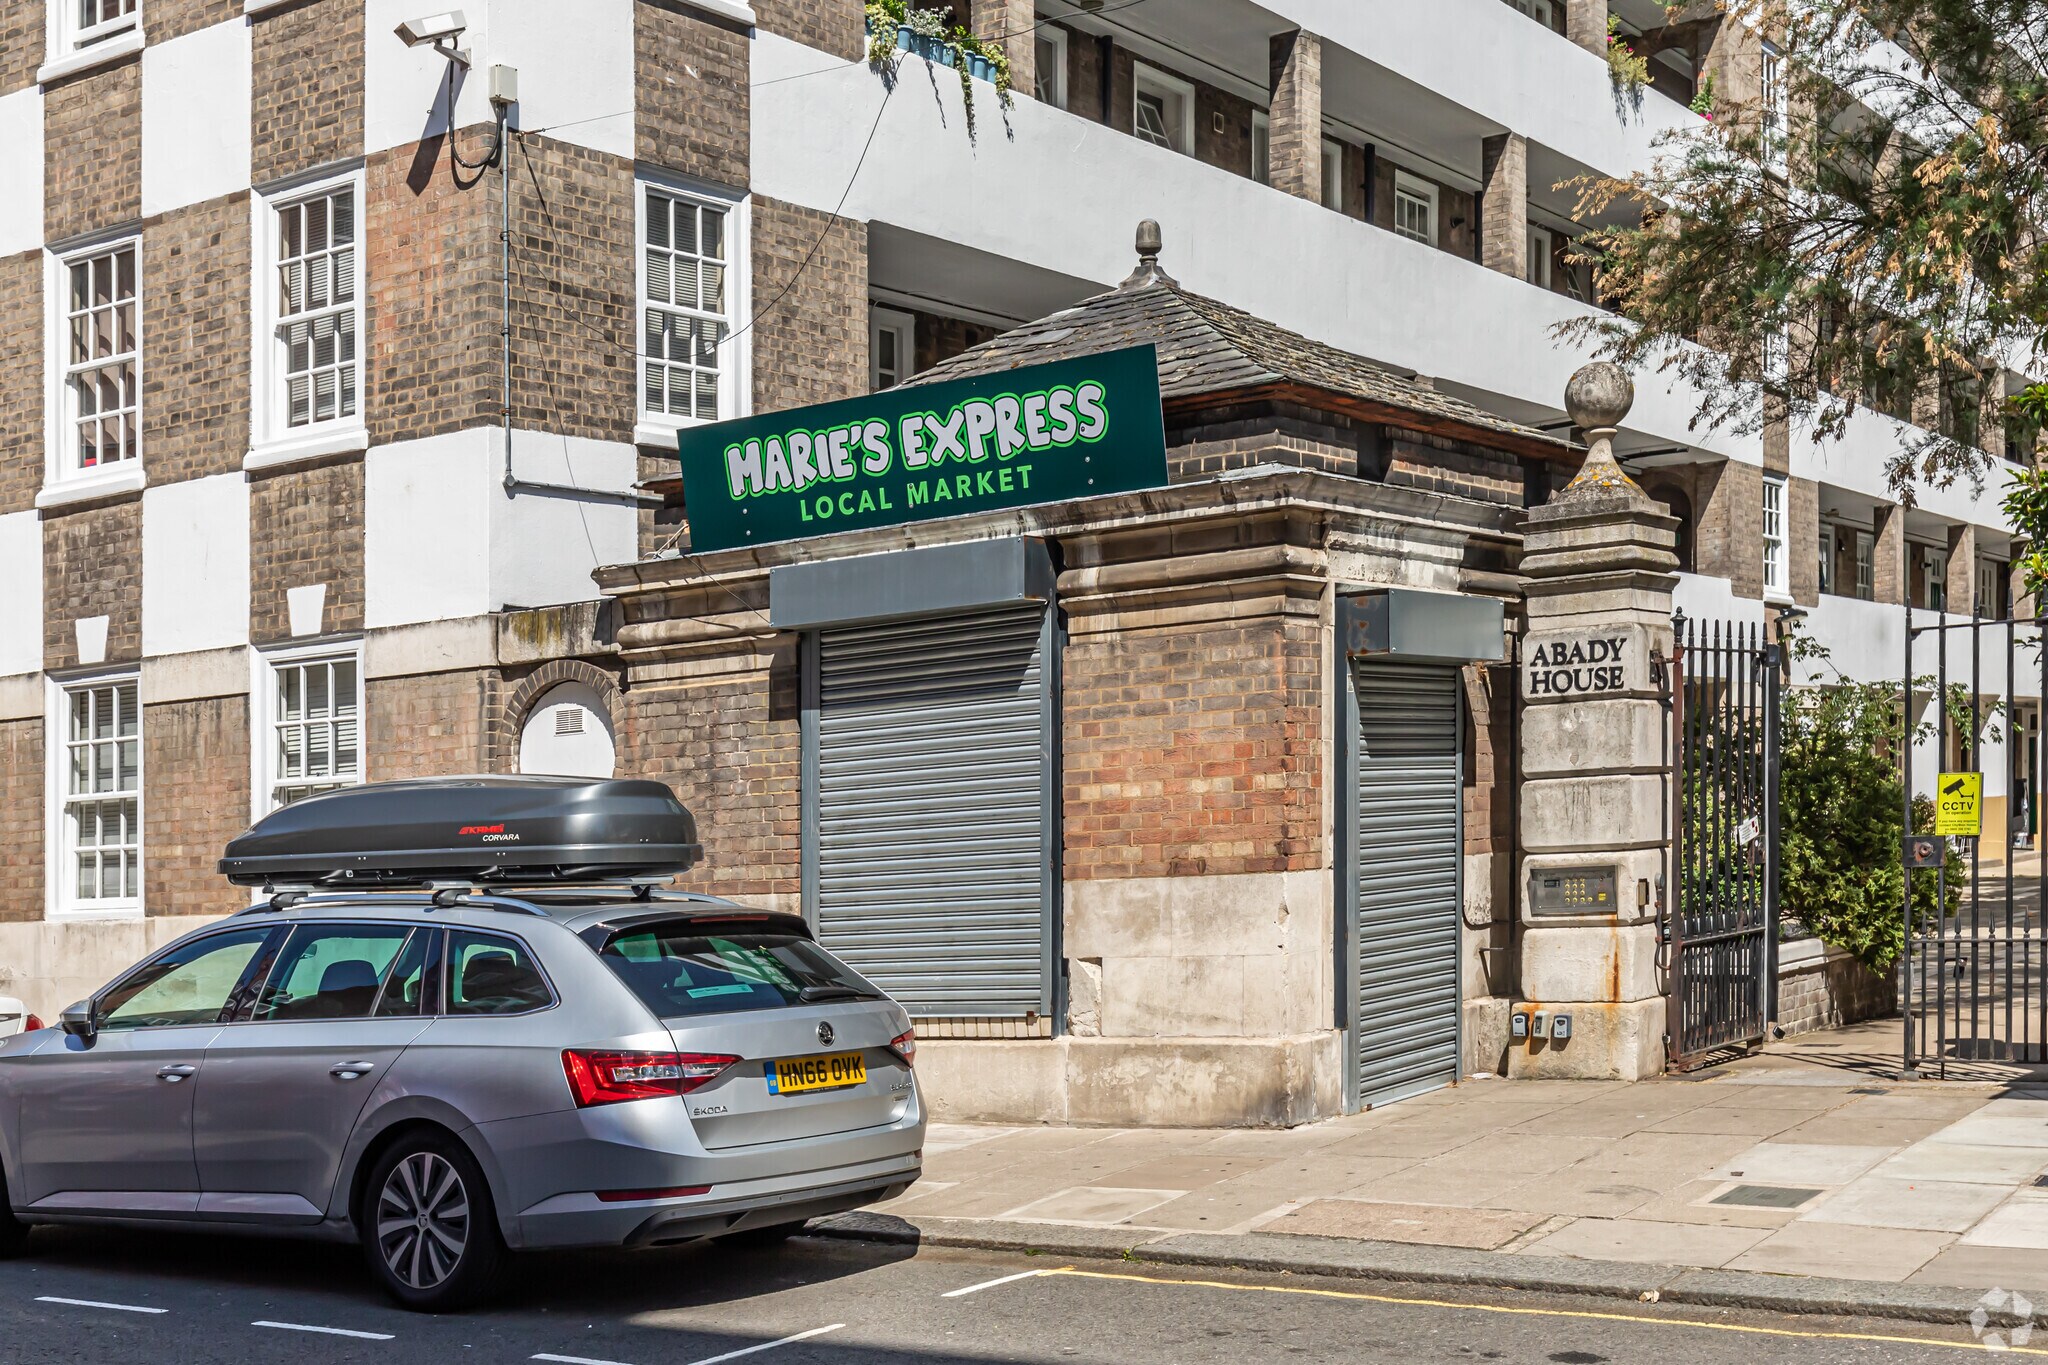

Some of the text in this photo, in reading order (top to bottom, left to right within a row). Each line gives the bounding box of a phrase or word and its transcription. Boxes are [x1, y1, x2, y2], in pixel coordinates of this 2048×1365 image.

[725, 383, 1107, 498] MARIE'S EXPRESS
[800, 464, 1033, 522] LOCAL MARKET
[1530, 638, 1627, 667] ABADY
[1530, 666, 1625, 694] HOUSE
[1942, 802, 1973, 810] CCTV
[482, 833, 520, 842] CORVARA
[779, 1056, 864, 1087] HN66 OVK
